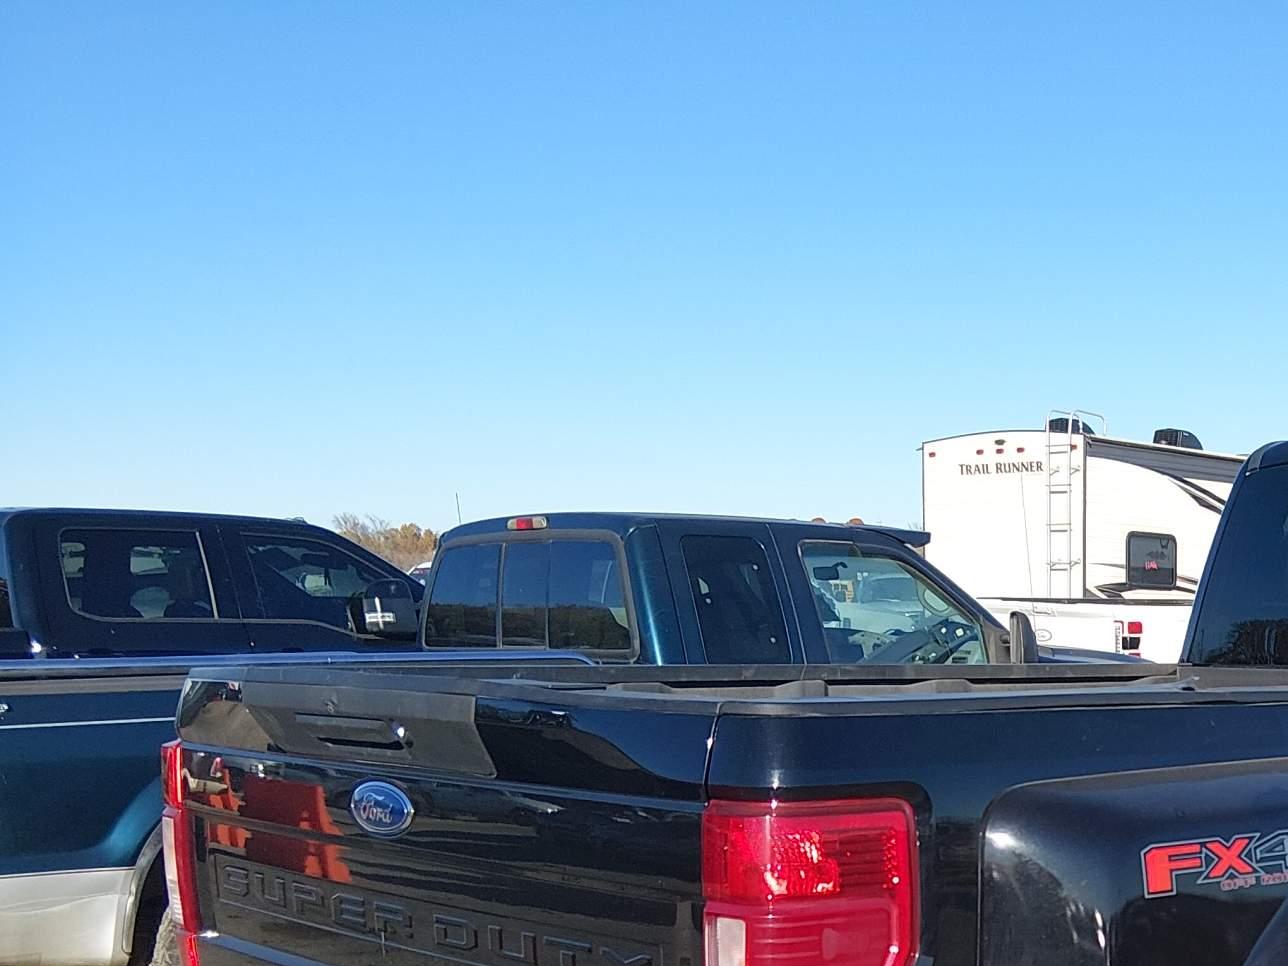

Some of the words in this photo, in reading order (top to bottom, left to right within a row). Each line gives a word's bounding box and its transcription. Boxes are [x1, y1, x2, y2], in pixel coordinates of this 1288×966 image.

[959, 463, 990, 475] TRAIL
[995, 461, 1044, 474] RUNNER
[360, 792, 393, 823] Ford
[220, 863, 414, 939] SUPER
